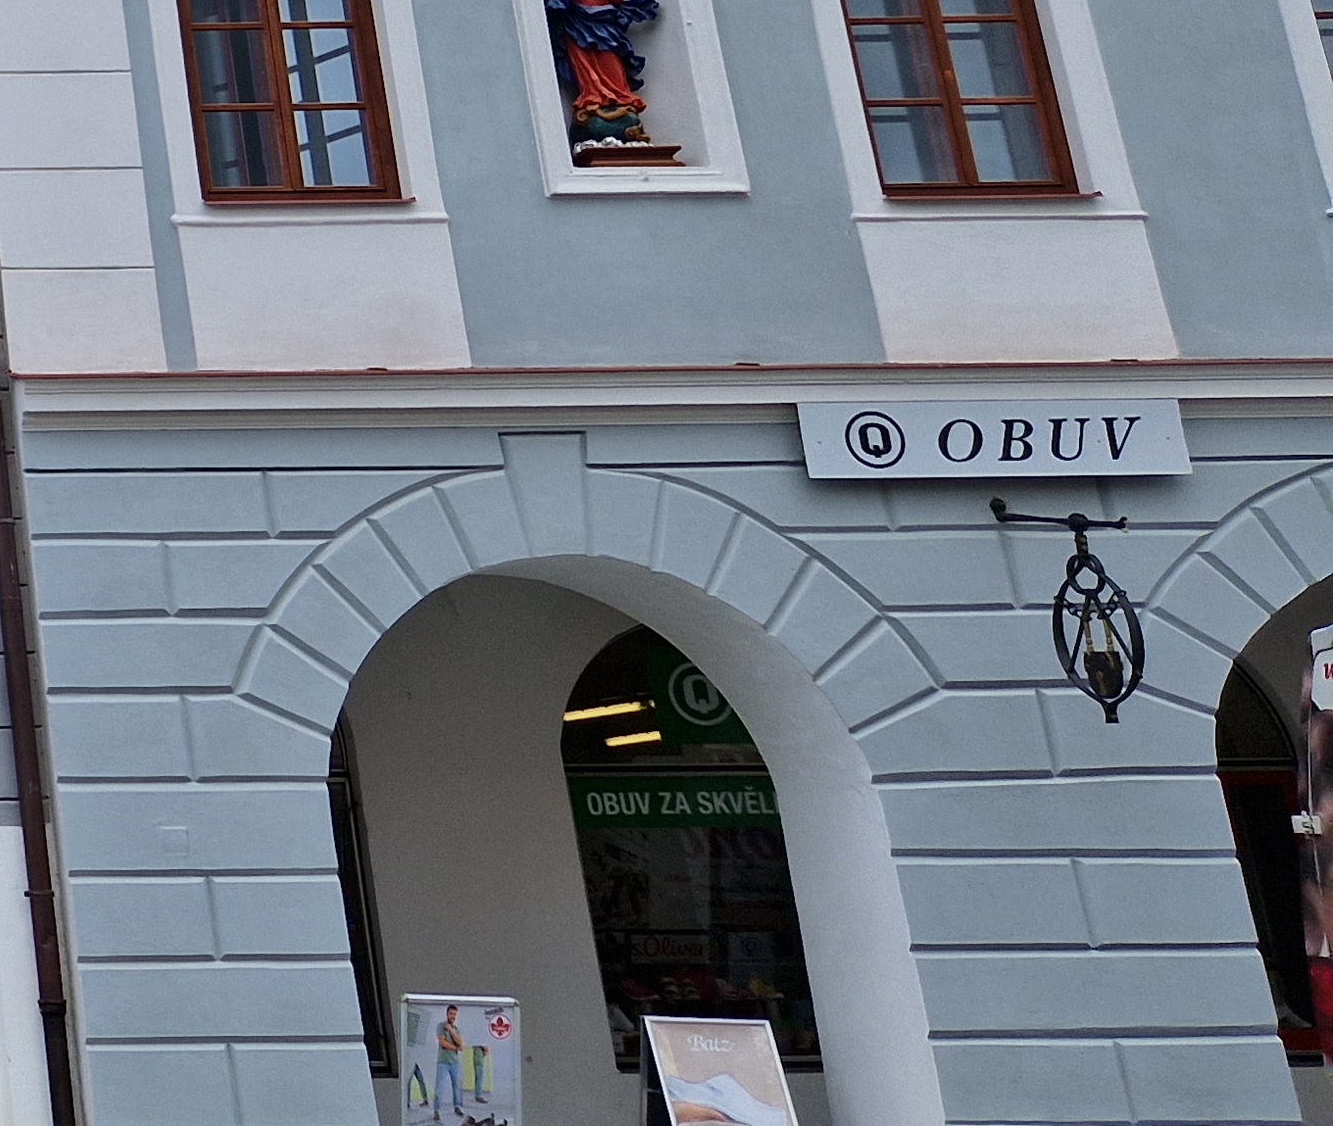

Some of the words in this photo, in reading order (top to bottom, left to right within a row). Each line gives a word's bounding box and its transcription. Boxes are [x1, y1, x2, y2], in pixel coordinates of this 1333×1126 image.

[938, 416, 1141, 463] OBUV
[587, 791, 650, 816] OBUV
[657, 791, 693, 815] ZA
[697, 785, 780, 815] SKVĚL
